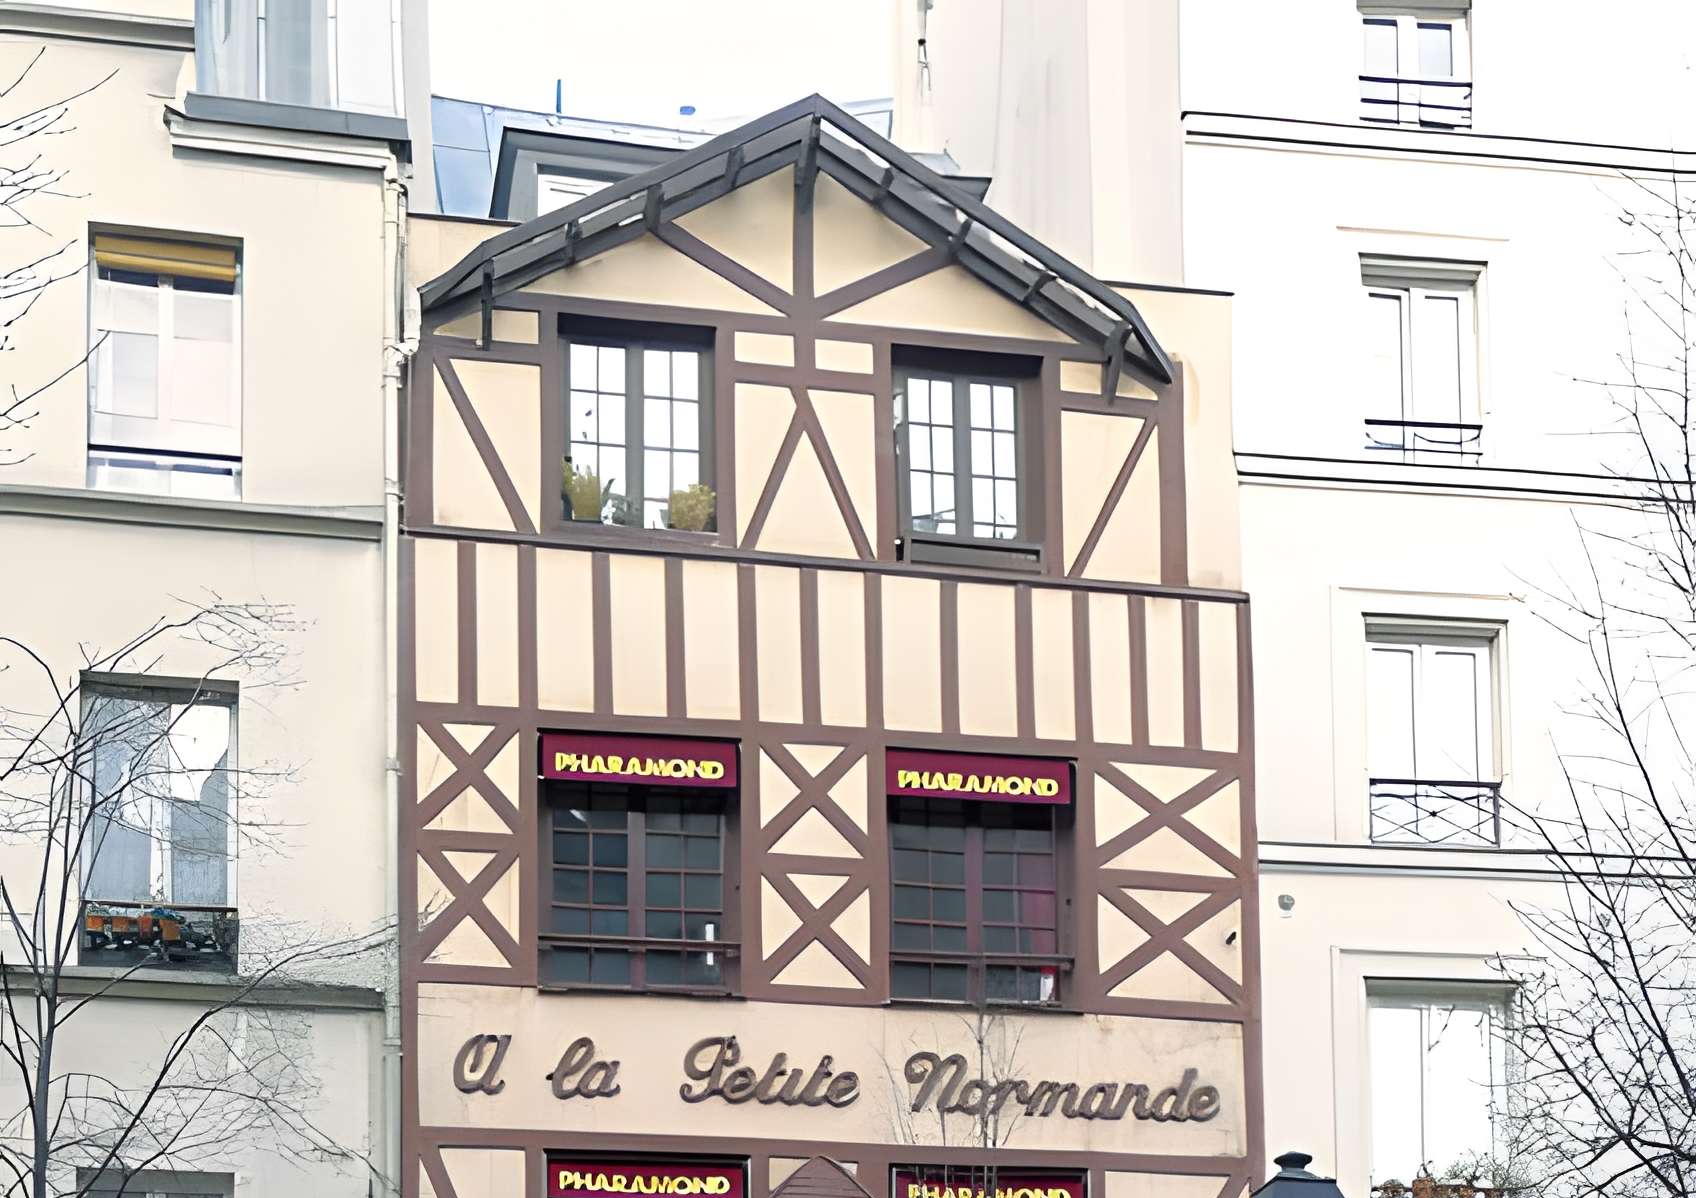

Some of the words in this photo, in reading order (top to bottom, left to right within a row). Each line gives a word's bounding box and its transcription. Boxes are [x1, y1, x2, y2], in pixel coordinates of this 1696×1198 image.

[555, 752, 724, 779] PHARAMOND
[898, 770, 1059, 796] PHARAMOND
[453, 1034, 512, 1095] A
[546, 1037, 621, 1099] la
[680, 1035, 861, 1108] Petite
[904, 1051, 1221, 1122] Normande
[559, 1171, 730, 1195] PHARAMOND
